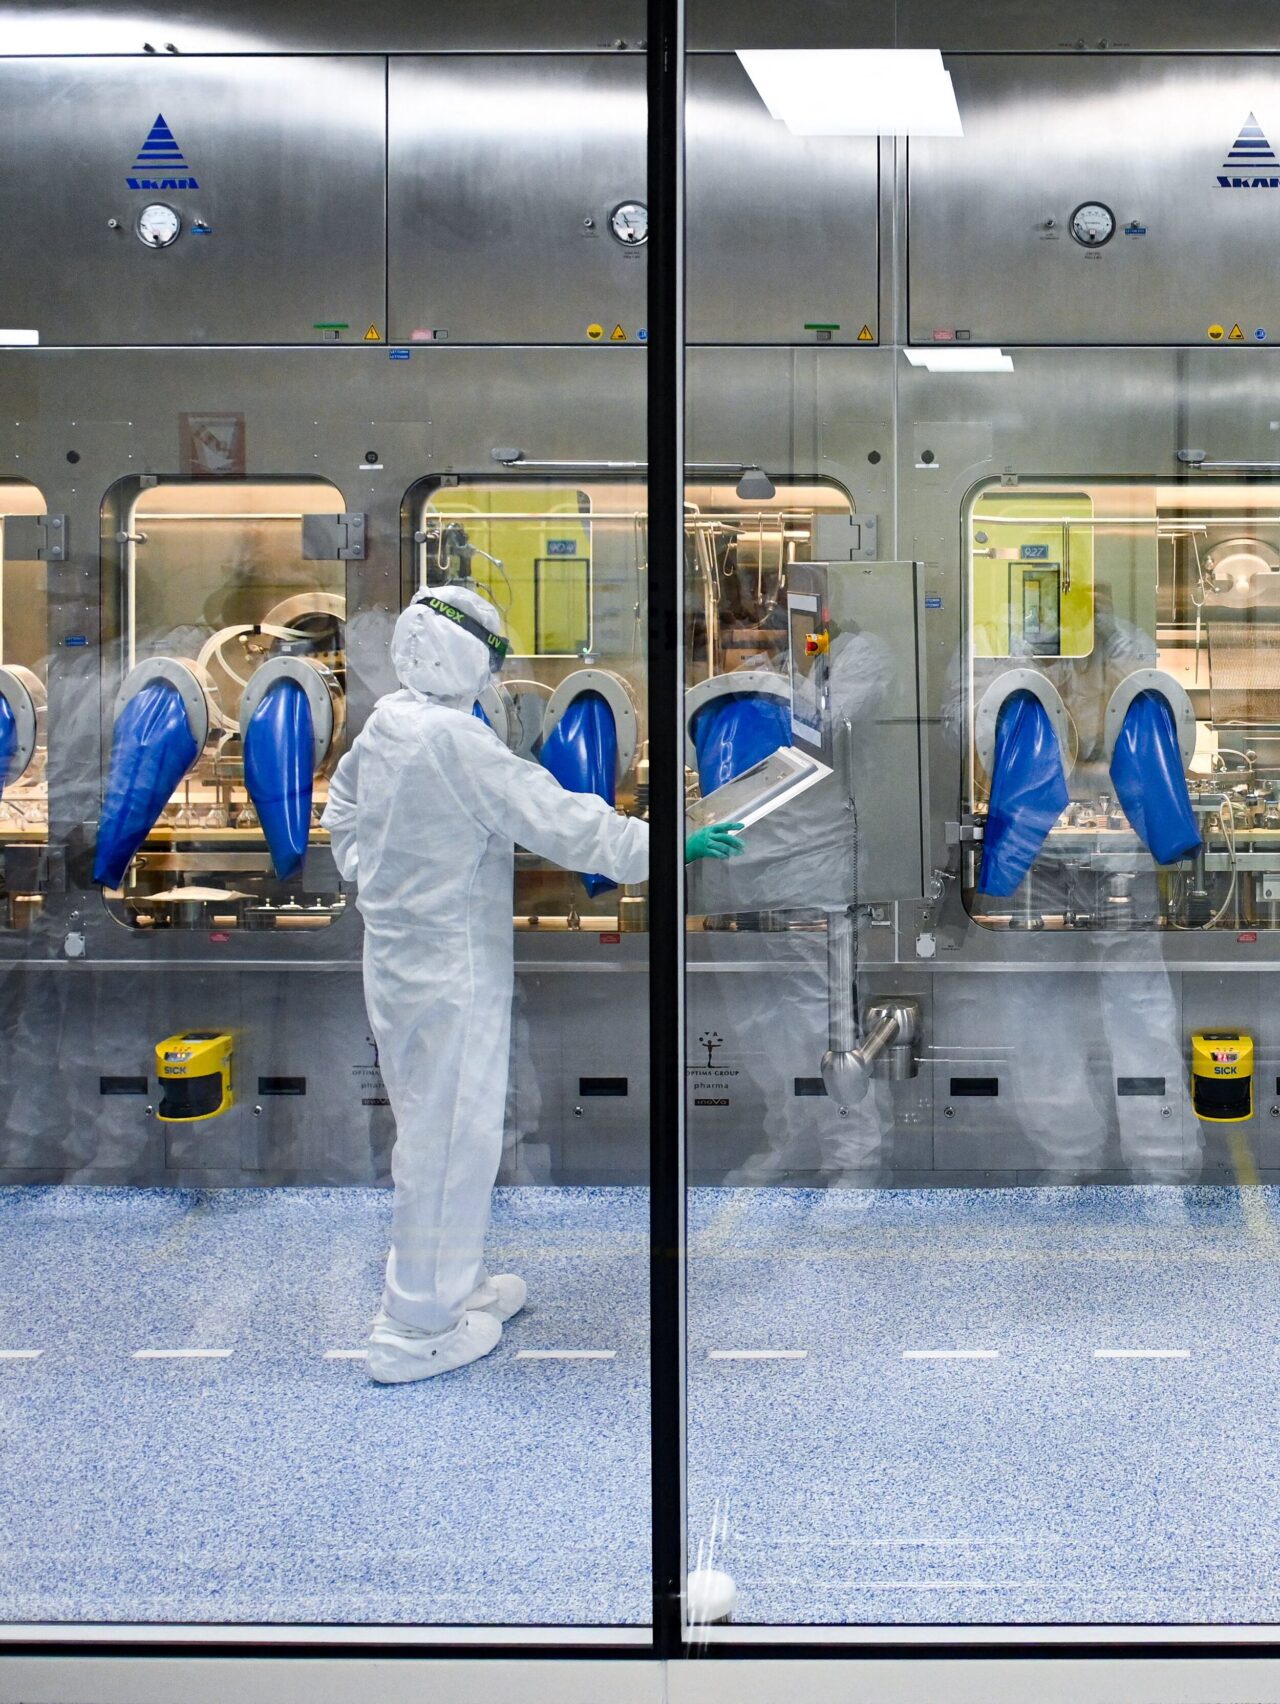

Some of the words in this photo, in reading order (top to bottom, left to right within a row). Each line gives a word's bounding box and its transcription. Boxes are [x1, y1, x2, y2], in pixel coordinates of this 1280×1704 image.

[429, 598, 465, 623] uvex
[164, 1066, 187, 1075] SICK
[1214, 1066, 1238, 1075] SICK
[694, 1082, 729, 1090] pharma
